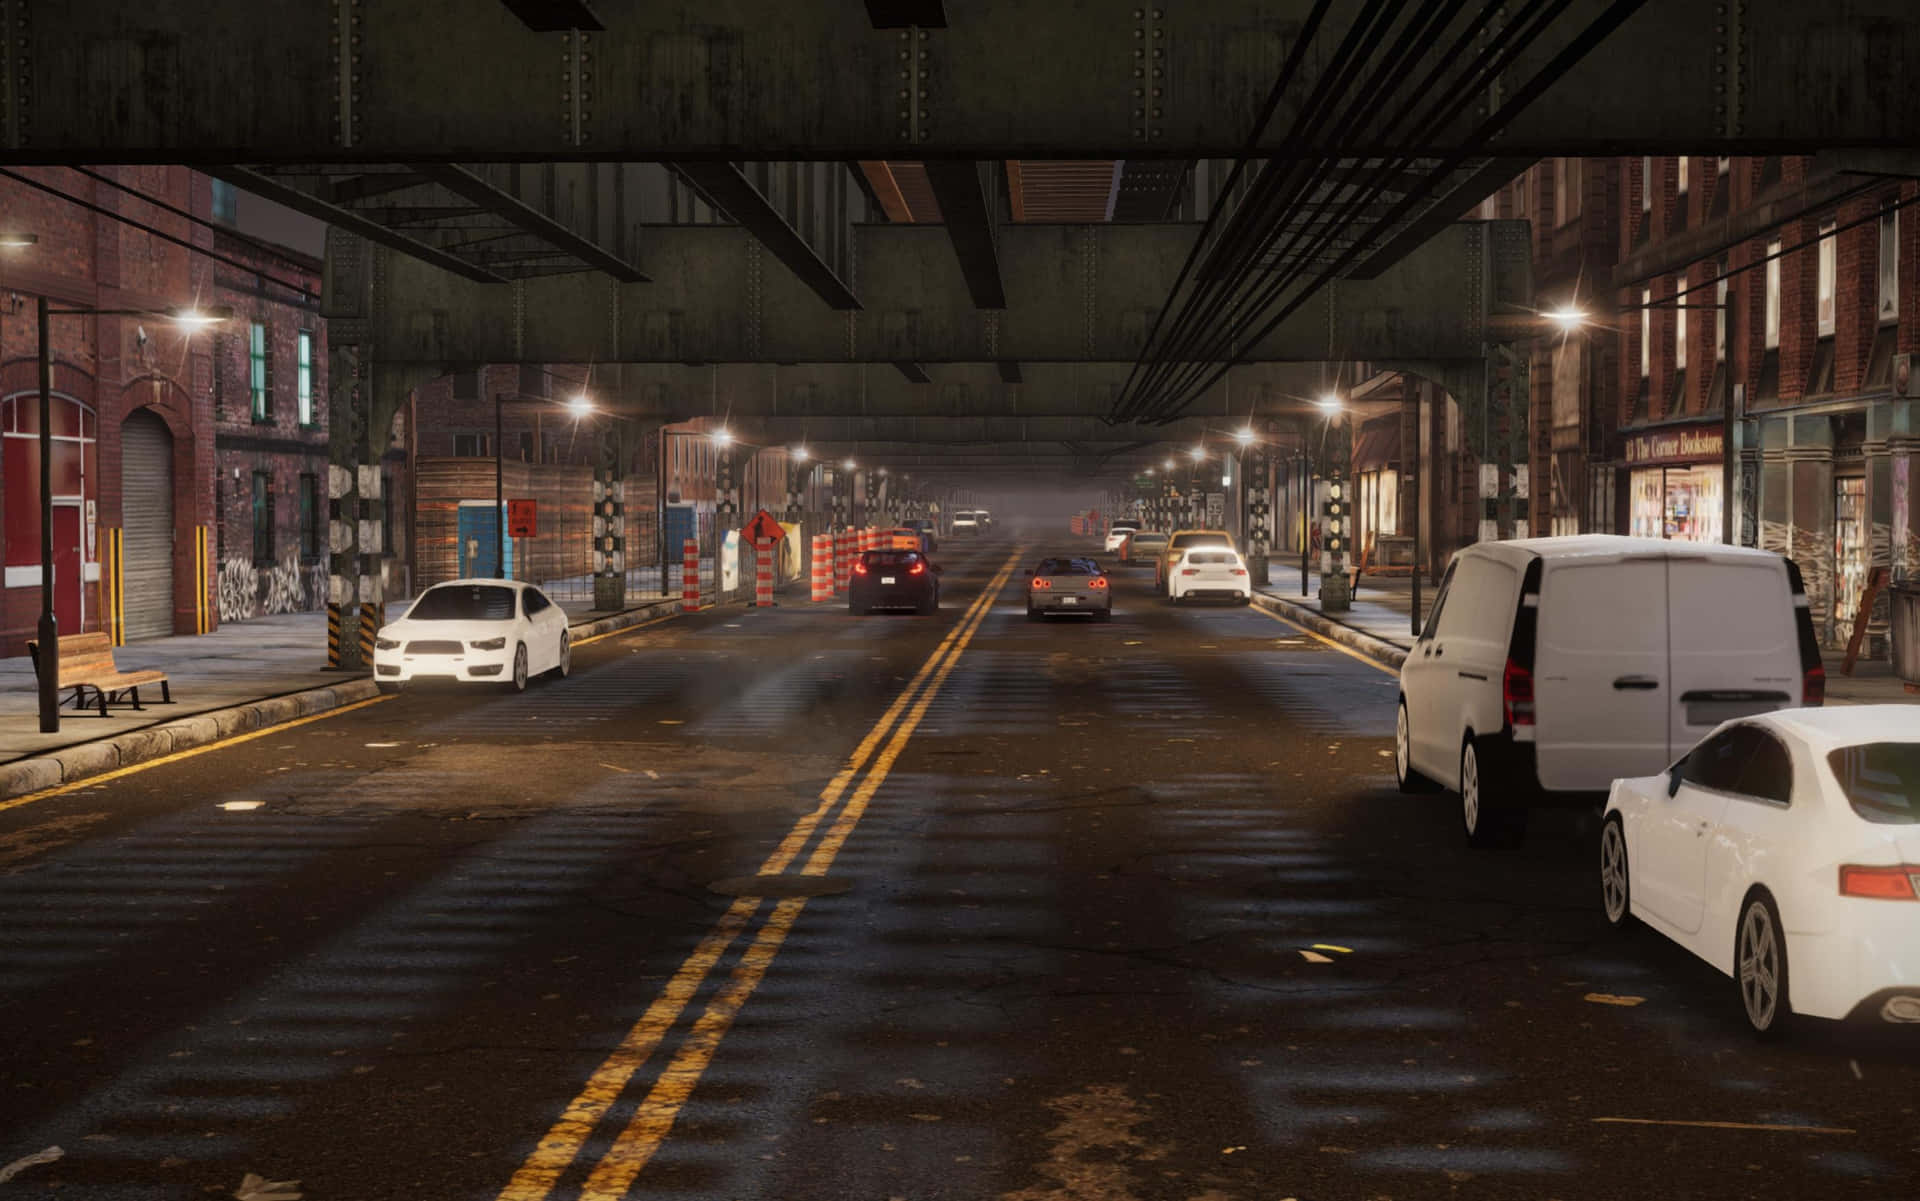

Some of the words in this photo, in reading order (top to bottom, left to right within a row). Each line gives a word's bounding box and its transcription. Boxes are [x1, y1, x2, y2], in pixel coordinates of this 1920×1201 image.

[1636, 437, 1649, 460] The
[1651, 435, 1679, 458] Corner
[1680, 430, 1723, 456] Bookstore
